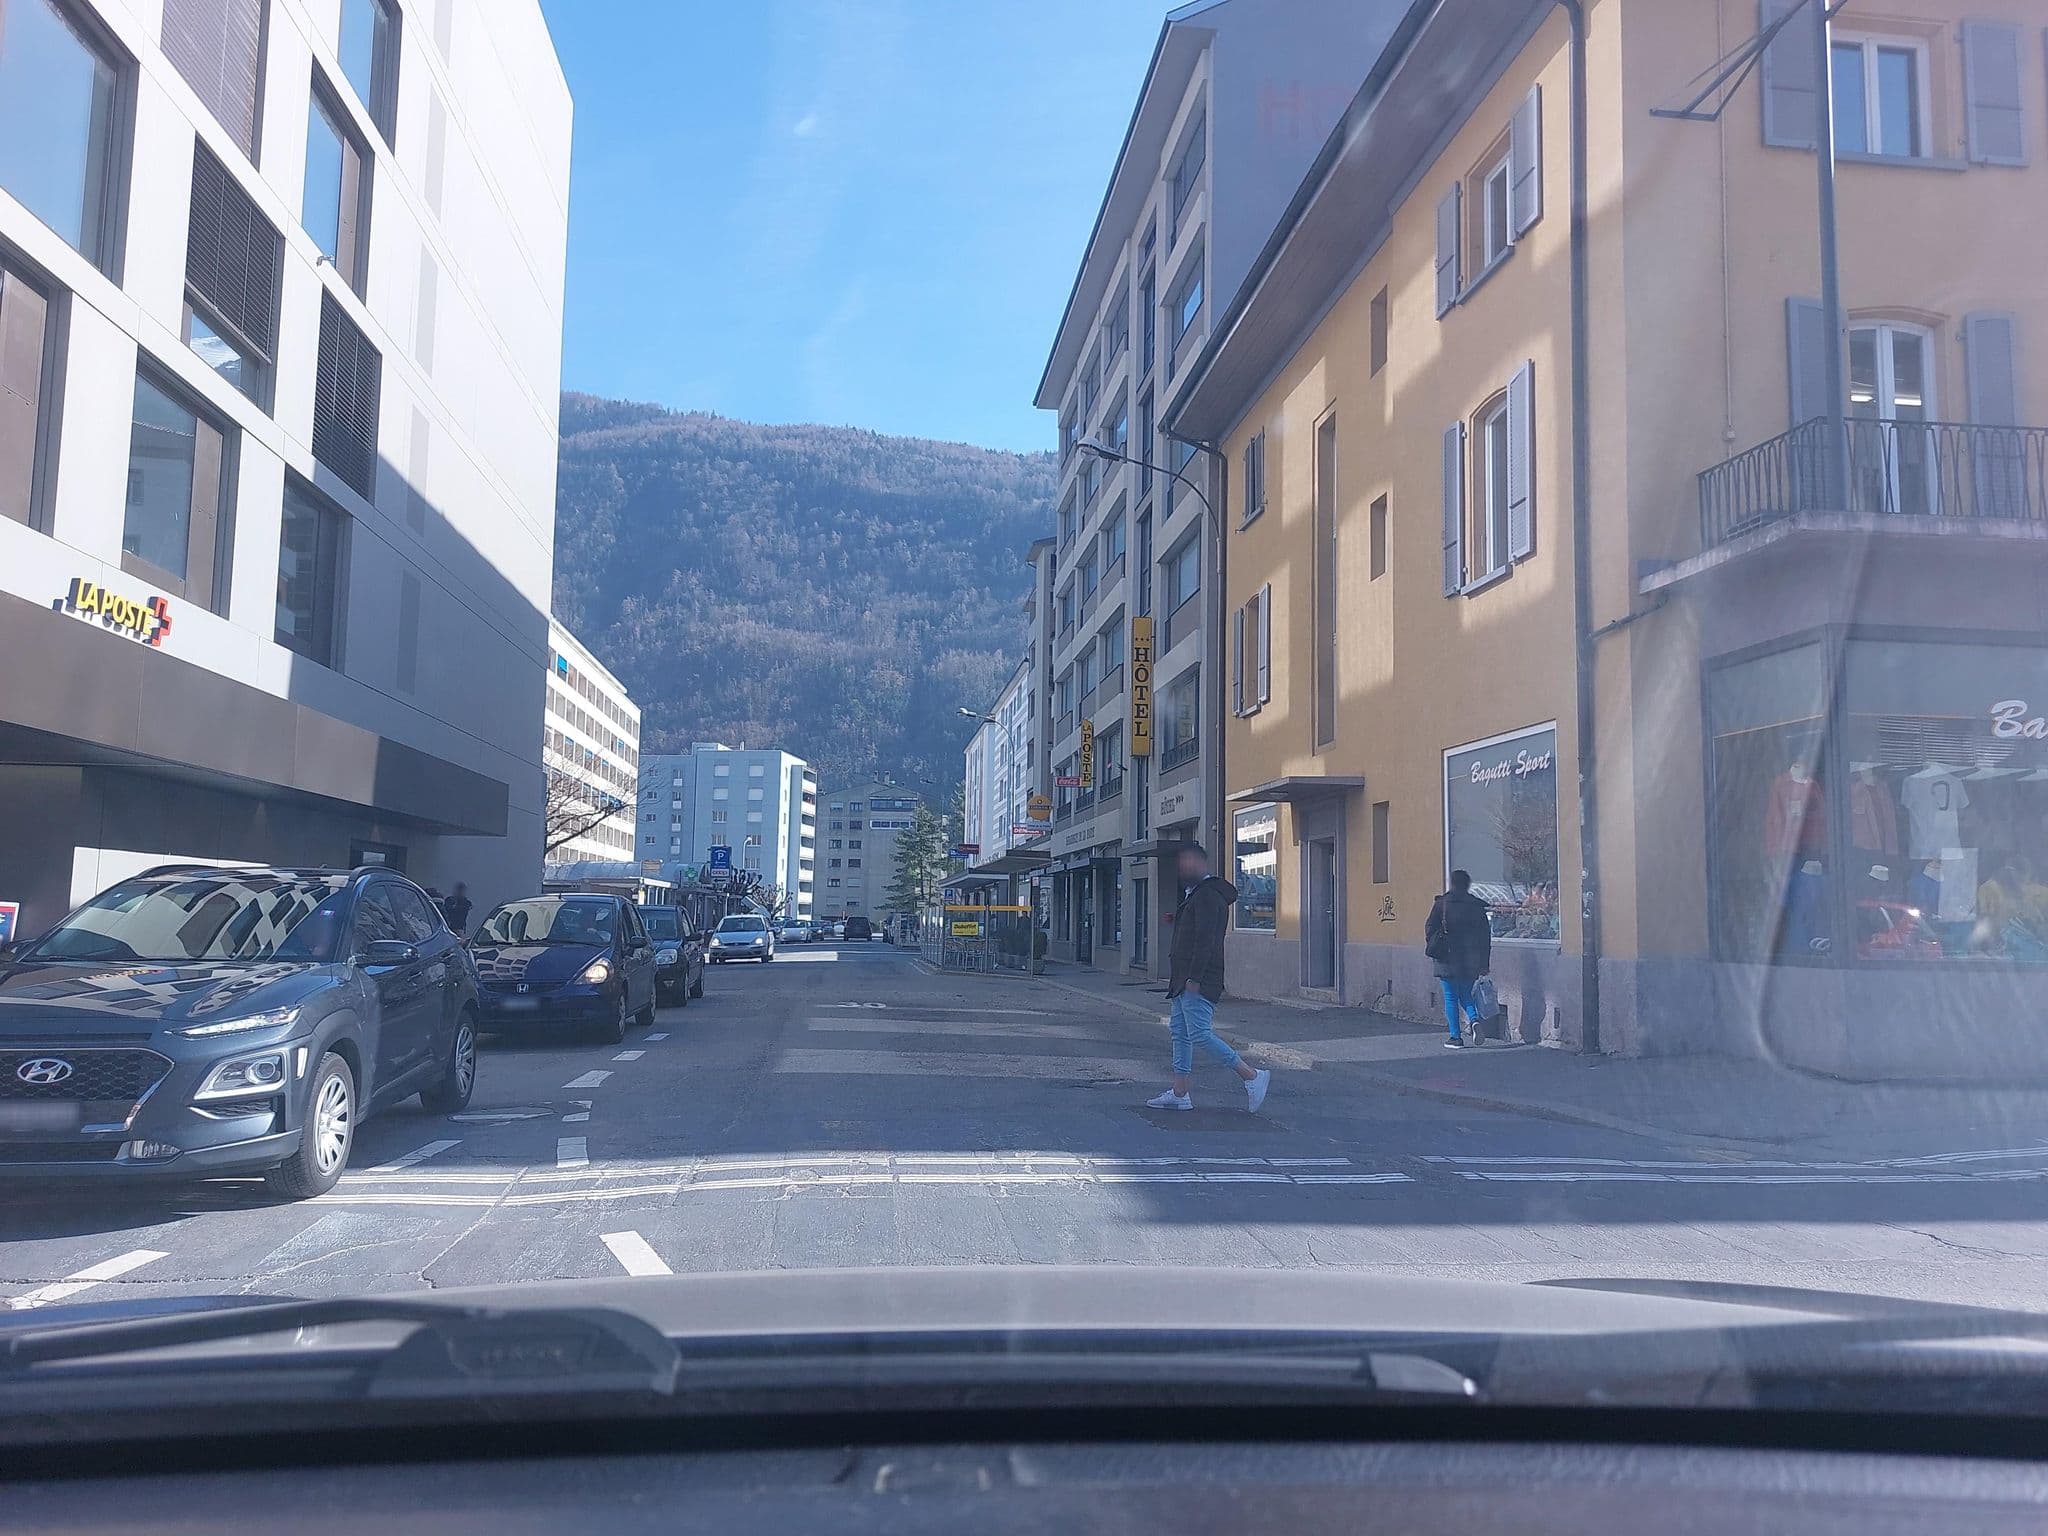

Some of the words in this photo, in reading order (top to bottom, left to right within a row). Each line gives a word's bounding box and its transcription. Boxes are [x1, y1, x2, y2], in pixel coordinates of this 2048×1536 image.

[76, 577, 98, 614] LA
[101, 591, 155, 635] POSTE
[1134, 647, 1150, 737] HÔTEL
[1082, 733, 1092, 783] POSTE
[1470, 759, 1512, 788] Bagutti
[1515, 748, 1551, 780] Sport
[717, 852, 725, 860] P
